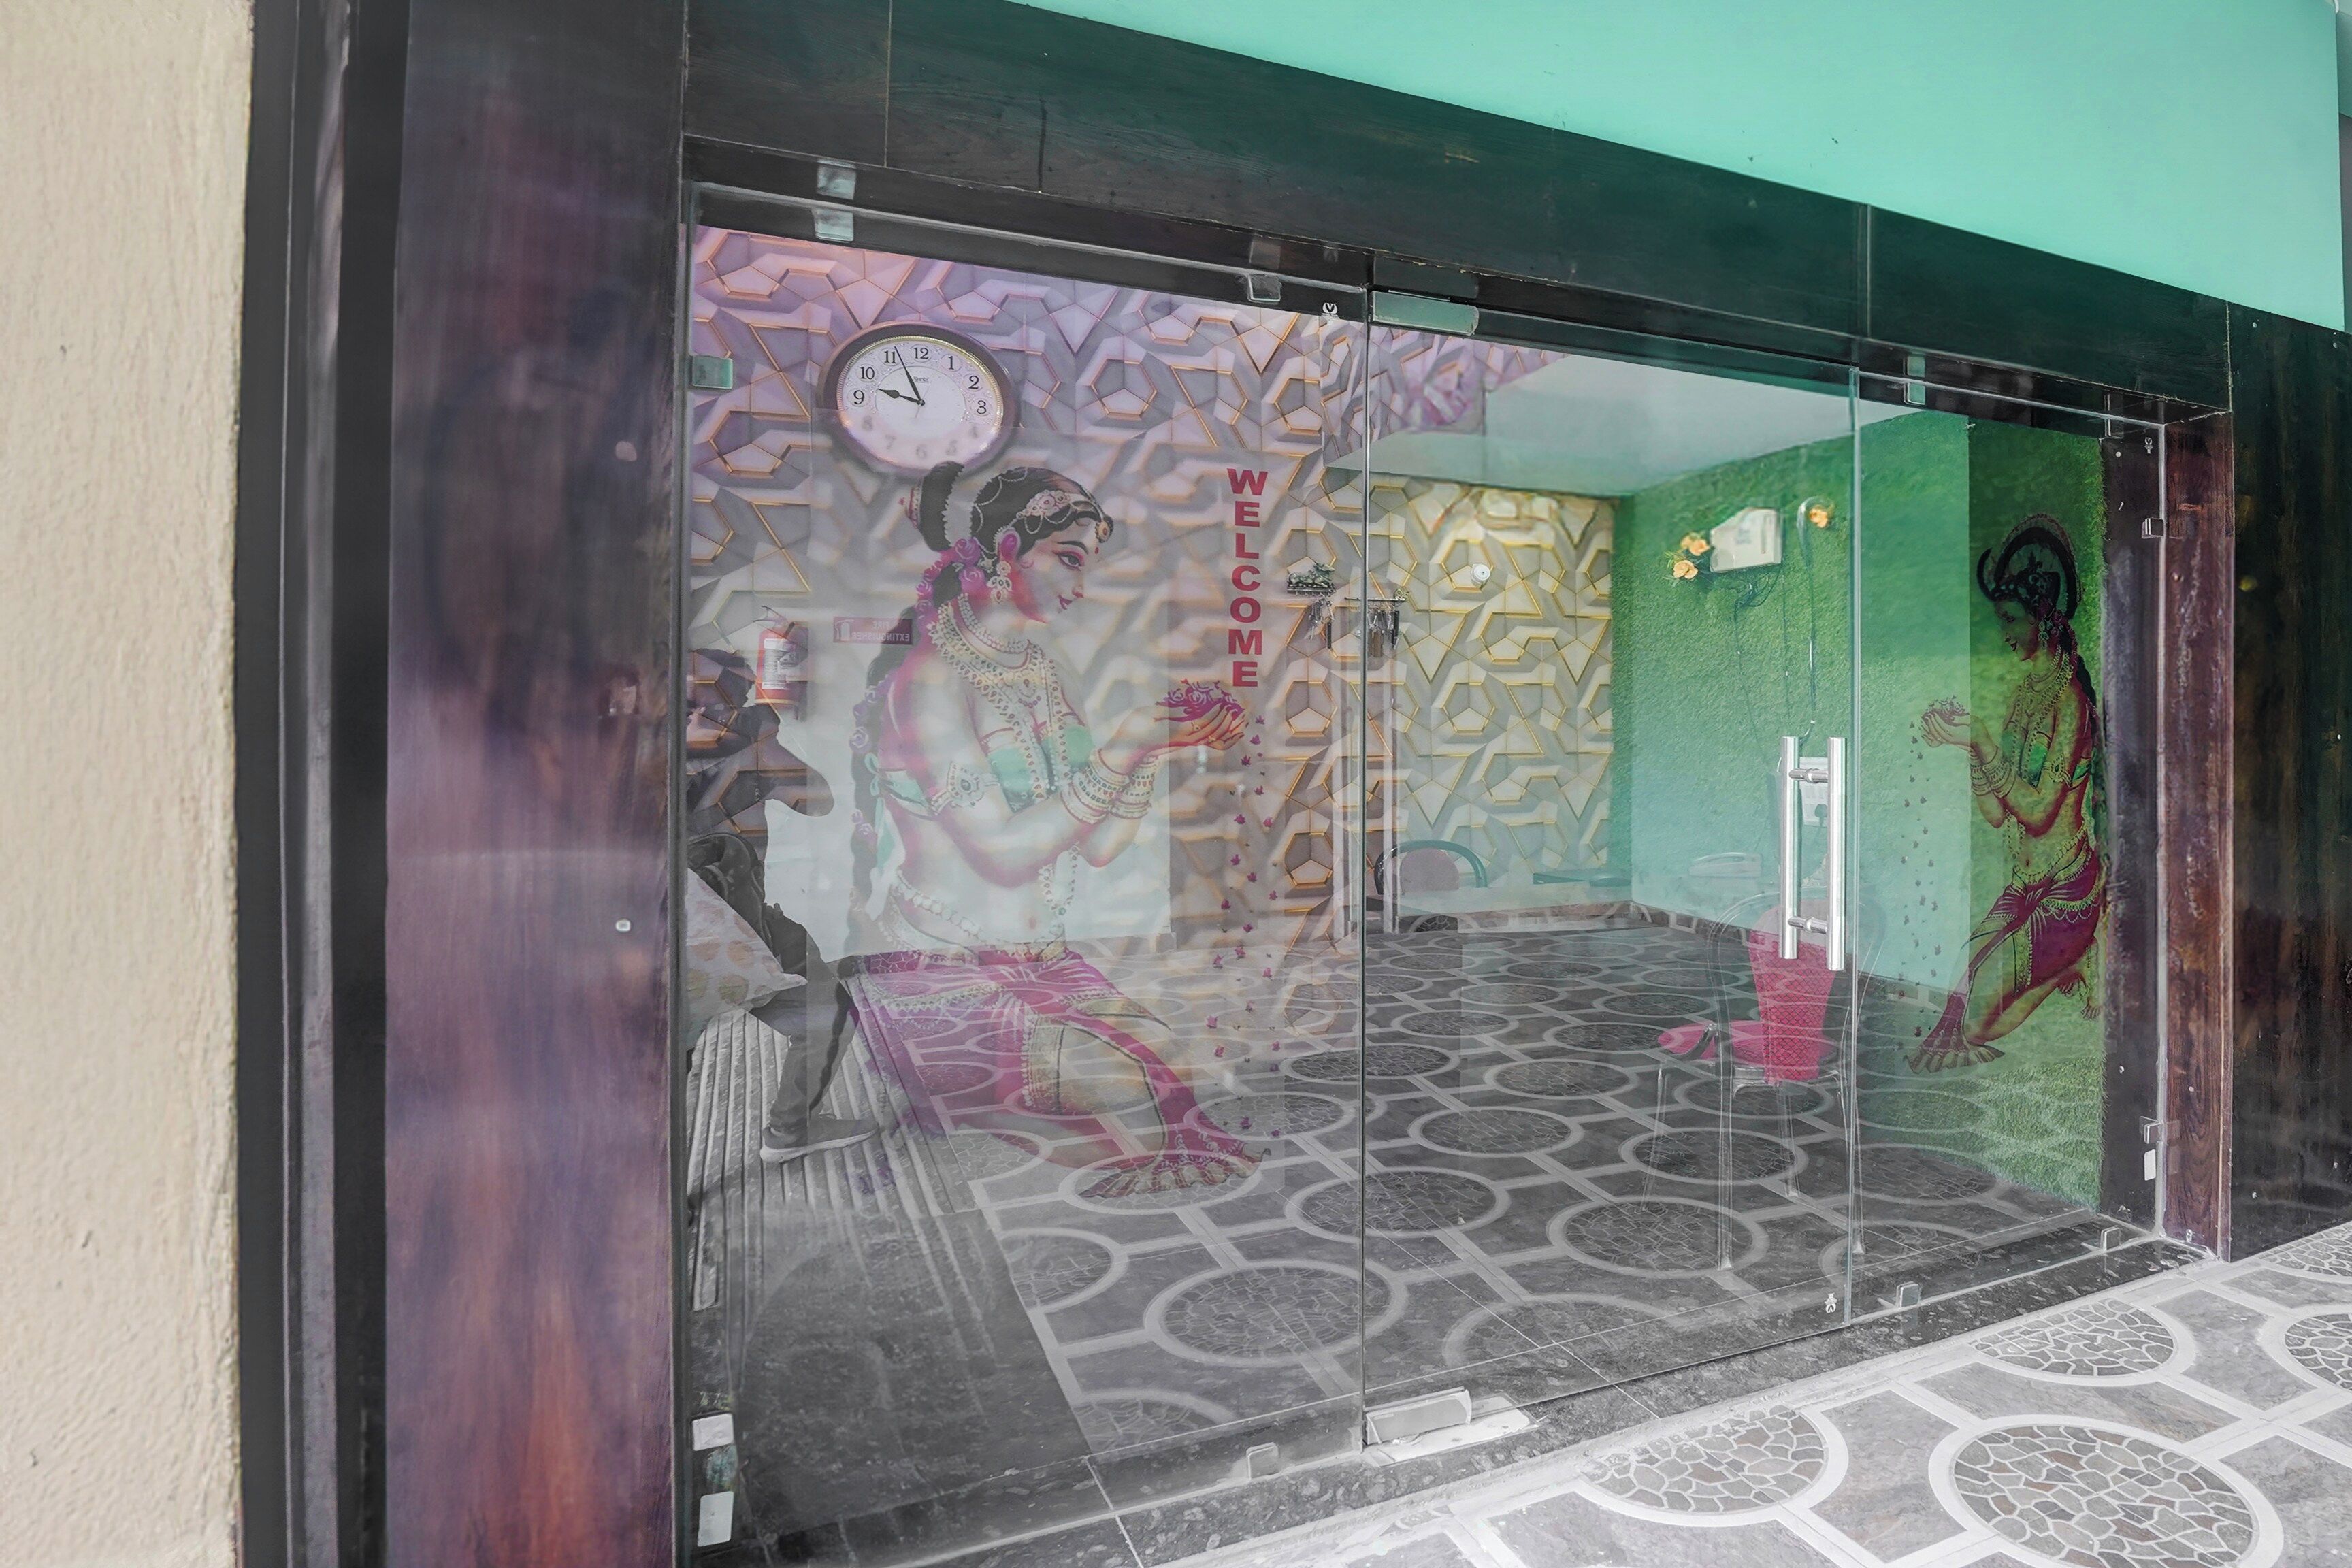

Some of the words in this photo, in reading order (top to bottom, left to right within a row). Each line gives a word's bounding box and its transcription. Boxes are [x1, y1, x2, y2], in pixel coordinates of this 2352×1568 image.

[885, 350, 896, 363] 11
[914, 347, 929, 359] 12
[948, 356, 954, 370] 1
[860, 367, 875, 379] 10
[968, 375, 980, 389] 2
[853, 390, 865, 405] 9
[977, 400, 987, 414] 3
[1227, 468, 1268, 687] WELCOME
